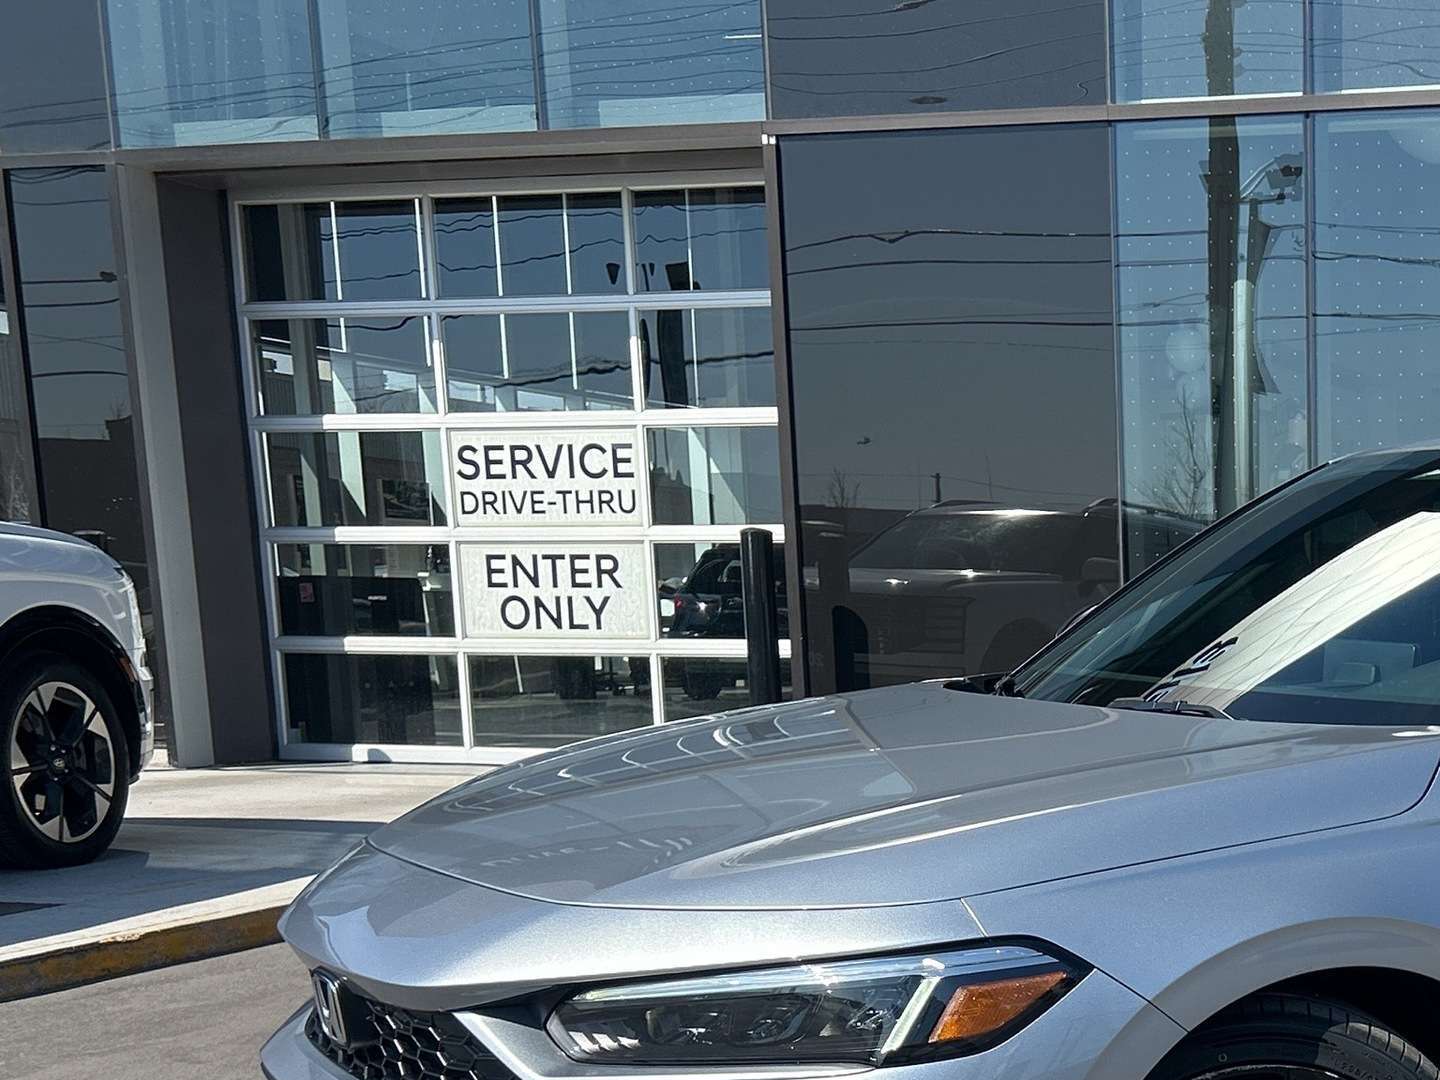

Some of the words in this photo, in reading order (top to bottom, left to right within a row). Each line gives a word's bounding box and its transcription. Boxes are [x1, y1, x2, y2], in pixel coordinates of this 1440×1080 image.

[456, 443, 634, 480] SERVICE
[459, 489, 637, 515] DRIVE-THRU
[485, 554, 623, 588] ENTER
[500, 595, 611, 630] ONLY
